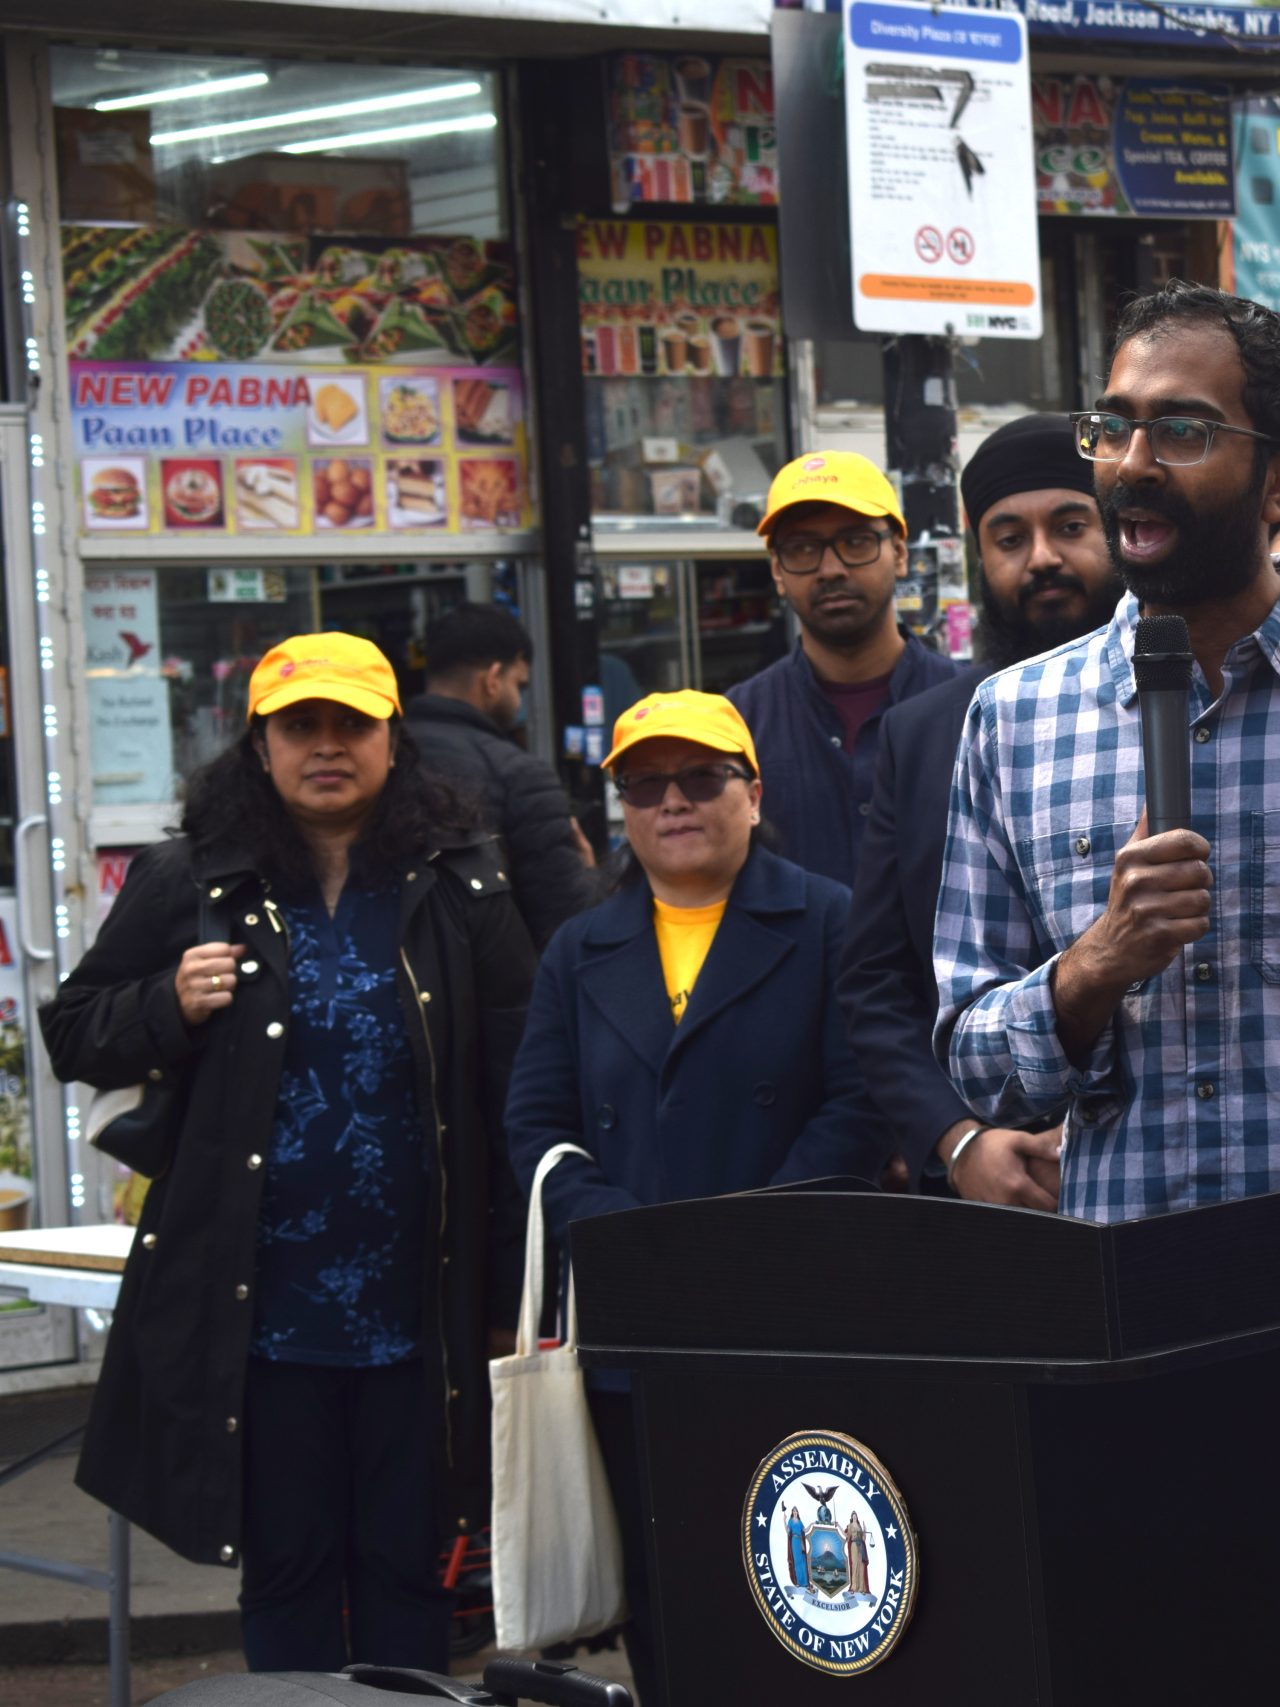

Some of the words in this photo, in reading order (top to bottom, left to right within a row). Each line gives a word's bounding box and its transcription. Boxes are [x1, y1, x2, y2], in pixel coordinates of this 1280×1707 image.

[1085, 3, 1159, 29] Jackson
[1244, 12, 1272, 36] NY
[576, 223, 630, 261] EW
[643, 224, 770, 263] PABNA
[578, 277, 654, 304] aan
[661, 266, 760, 306] Place
[76, 373, 175, 407] NEW
[186, 373, 312, 408] PABNA
[82, 418, 171, 449] Paan
[183, 416, 282, 449] Place
[770, 1450, 881, 1502] ASSEMBLY
[755, 1552, 796, 1631] STATE
[797, 1625, 826, 1652] OF
[828, 1630, 871, 1660] NEW
[870, 1567, 904, 1639] YORK
[811, 1599, 852, 1612] EXCELSIOR
